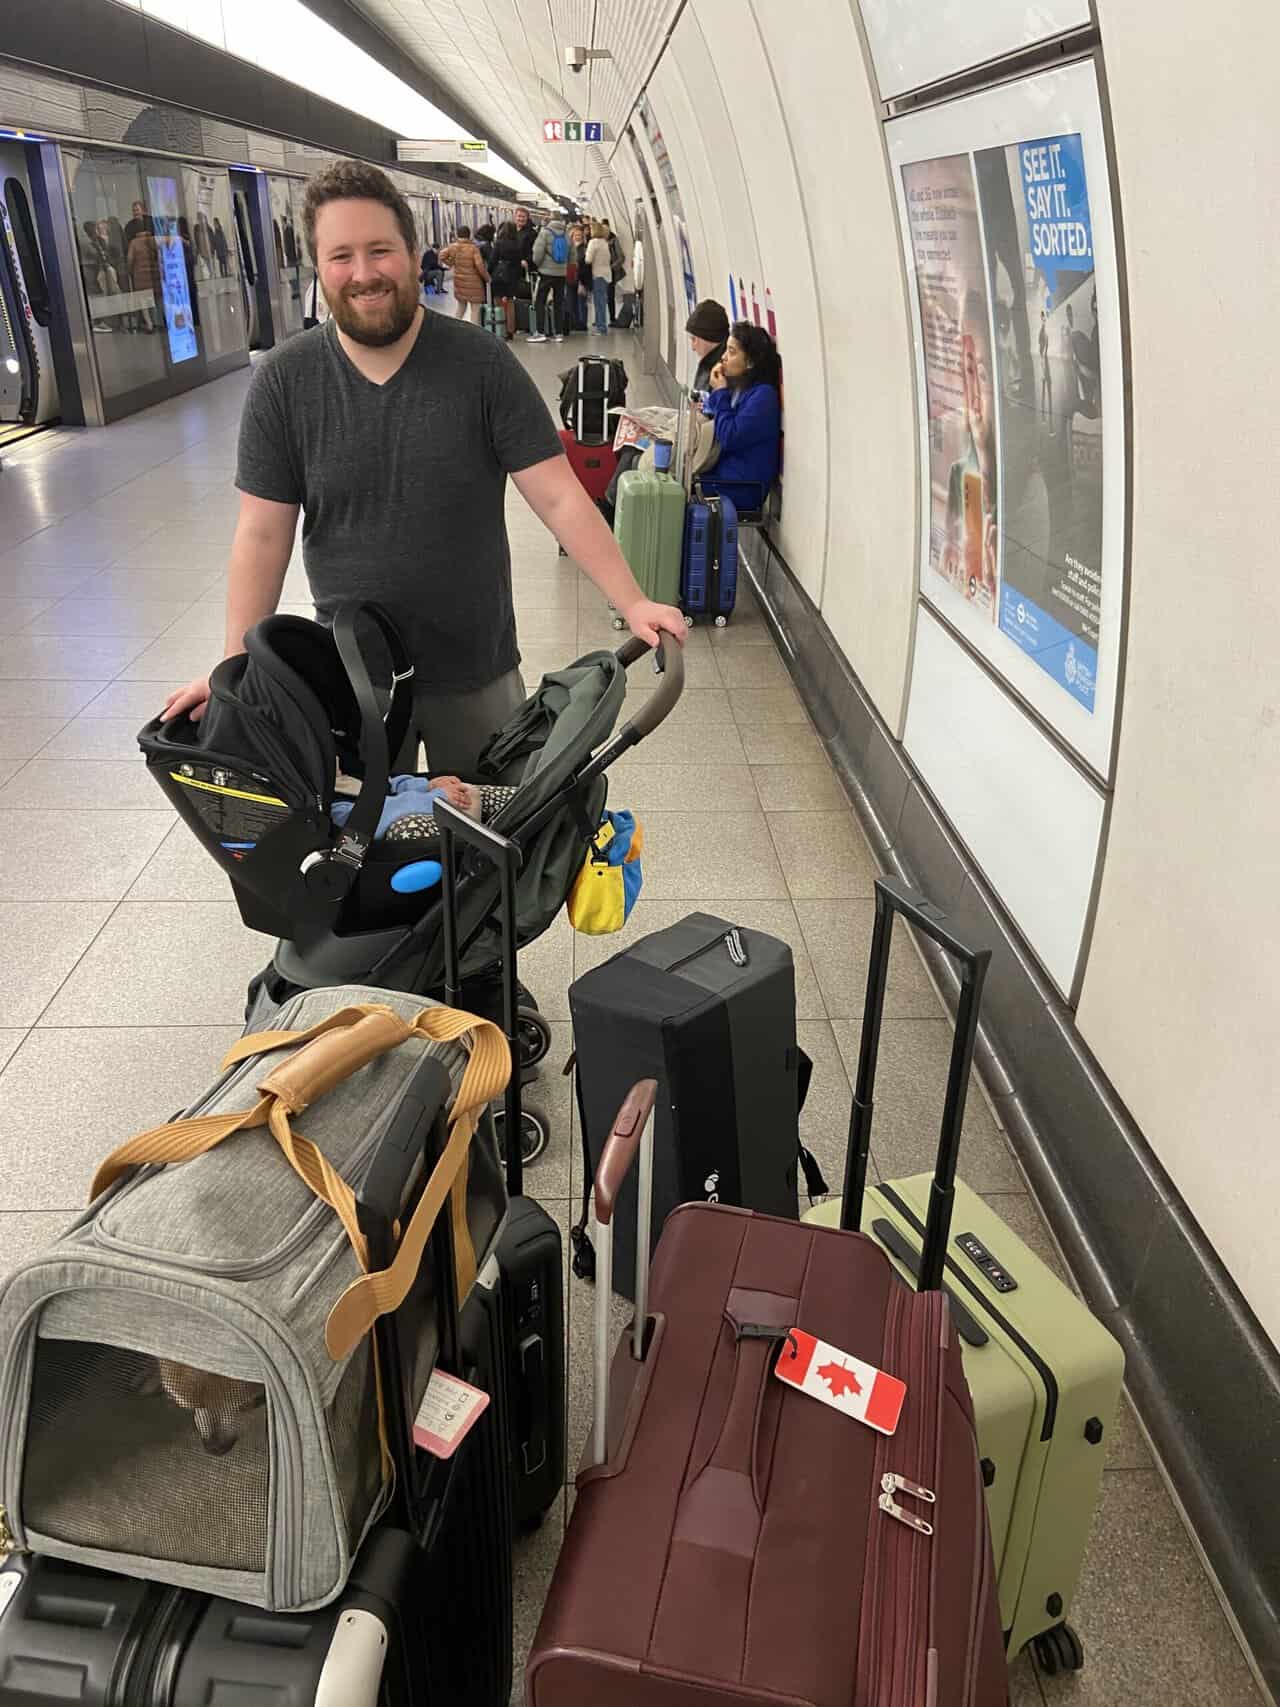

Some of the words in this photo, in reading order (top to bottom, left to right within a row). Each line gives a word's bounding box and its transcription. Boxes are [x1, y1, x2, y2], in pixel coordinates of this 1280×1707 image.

[1024, 147, 1050, 182] SEE
[1048, 143, 1066, 179] IT.
[1027, 184, 1052, 219] SAY
[1053, 183, 1071, 218] IT.
[1032, 221, 1092, 257] SORTED.
